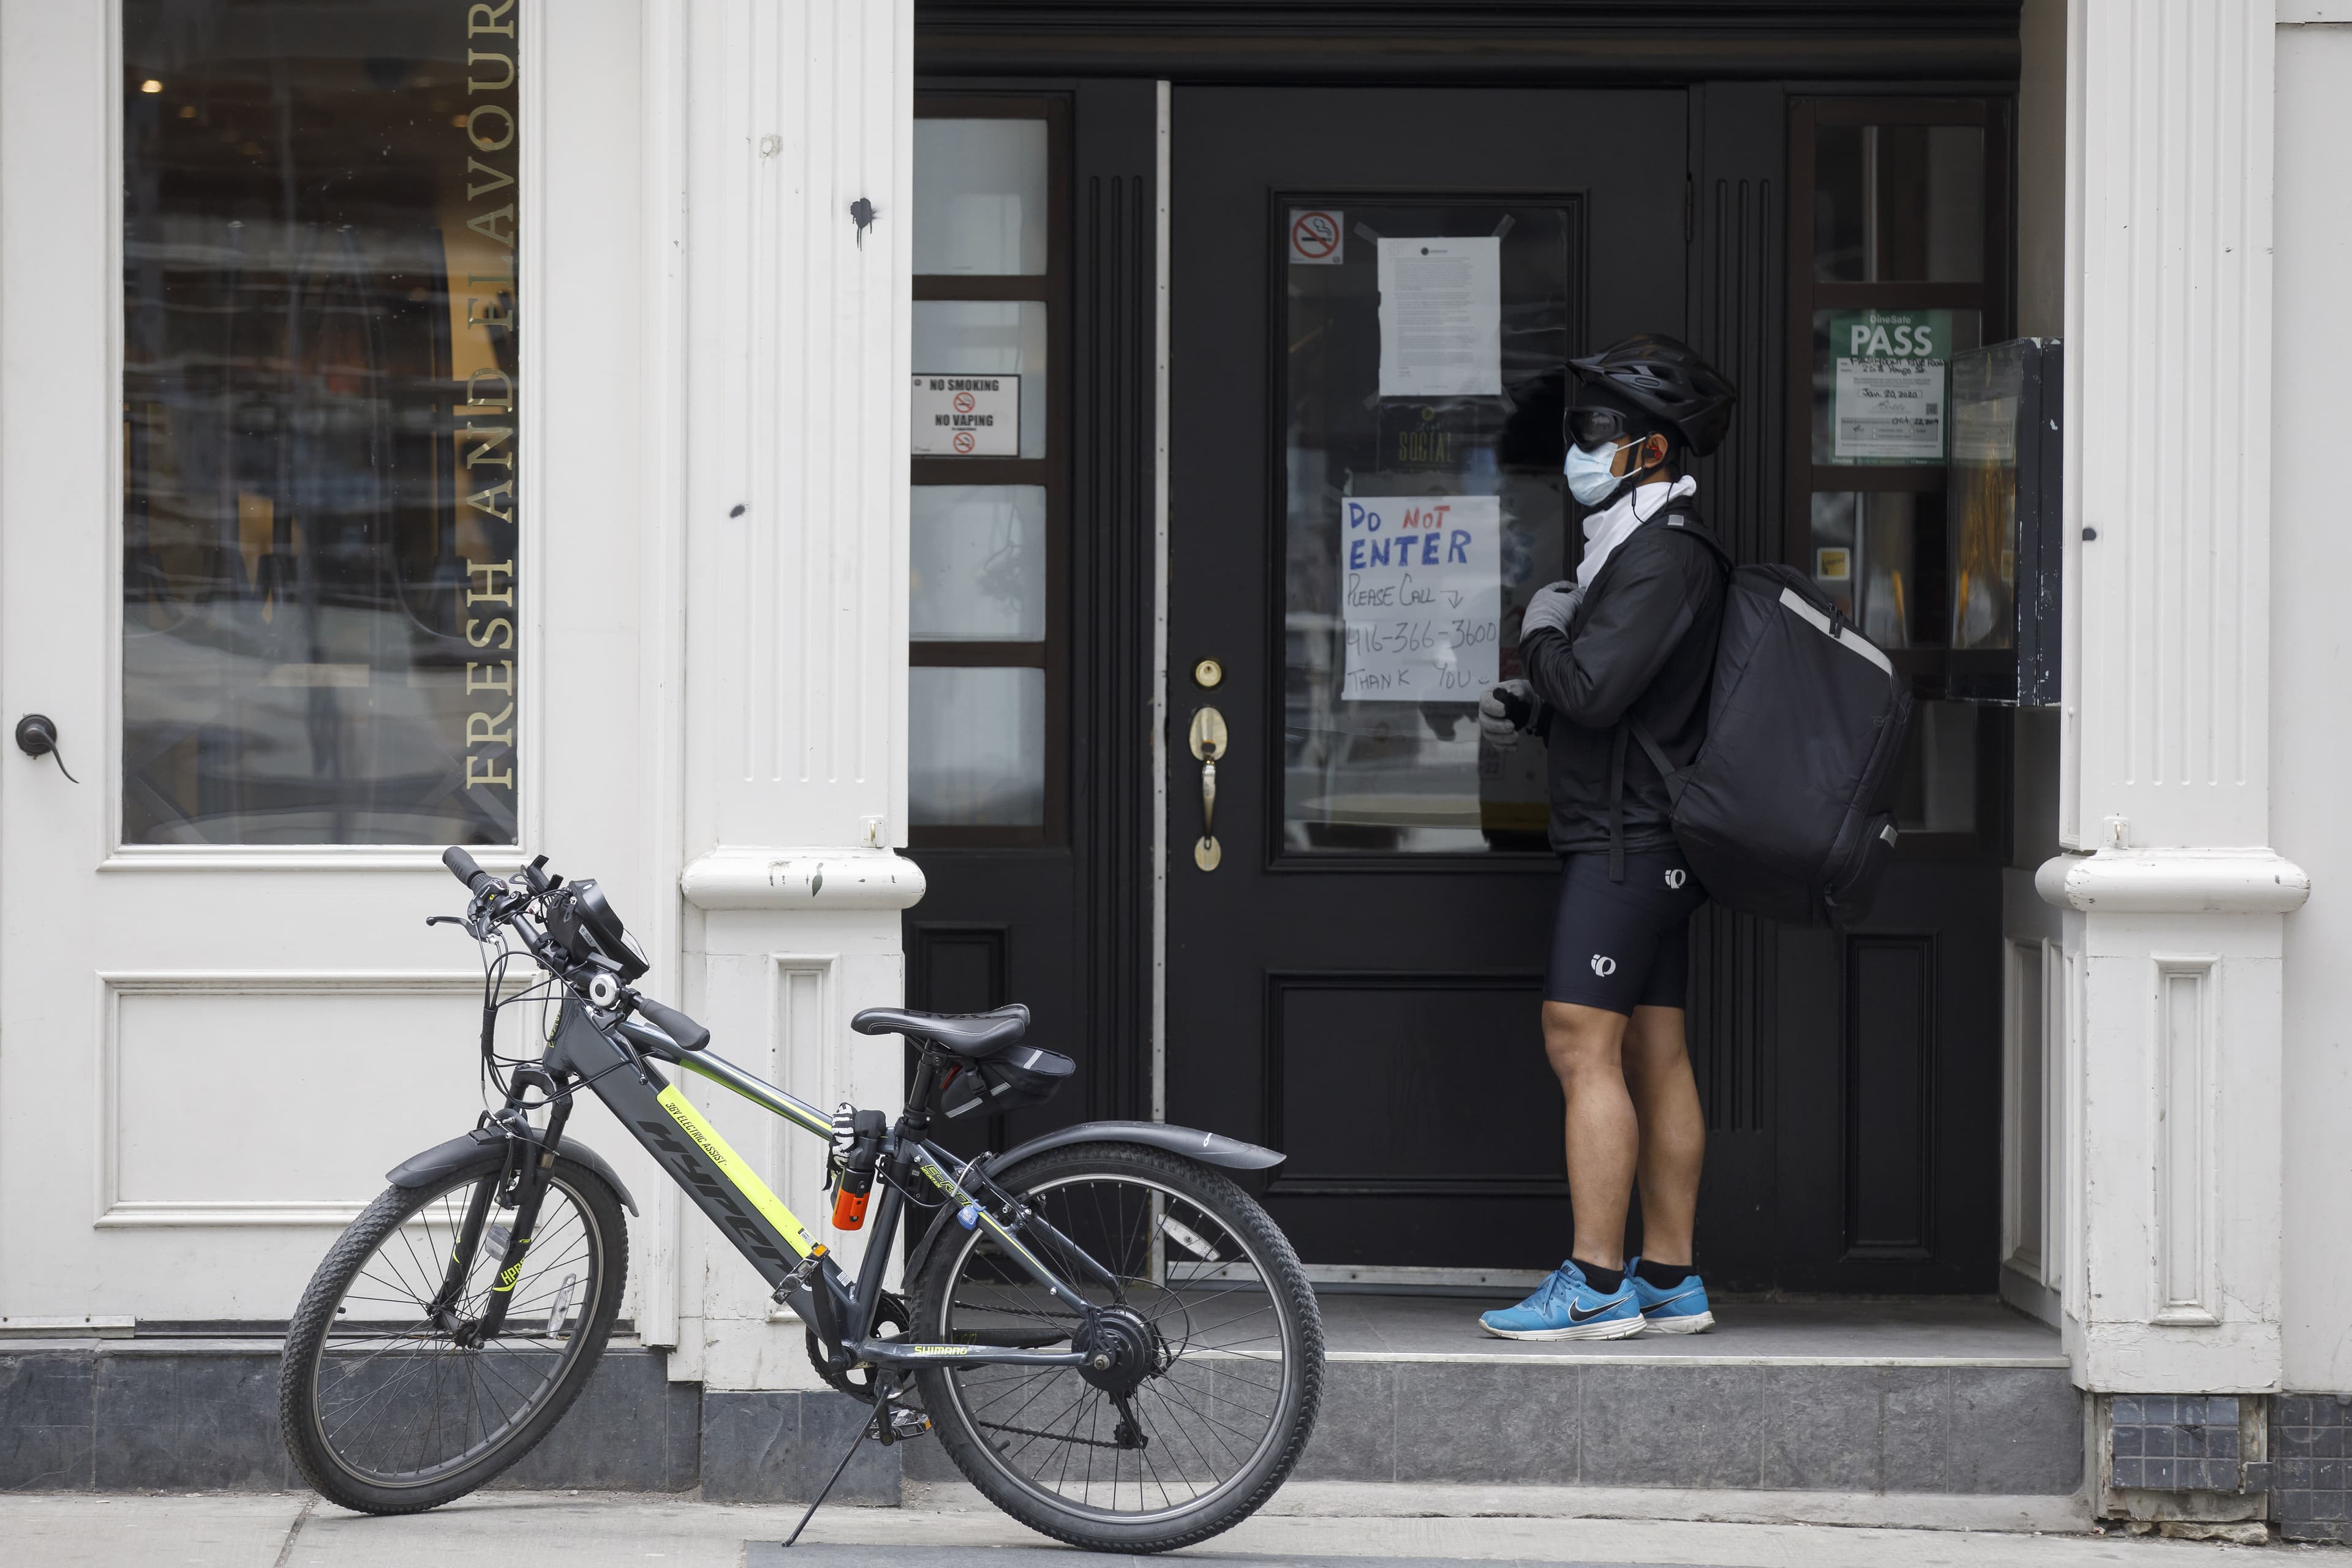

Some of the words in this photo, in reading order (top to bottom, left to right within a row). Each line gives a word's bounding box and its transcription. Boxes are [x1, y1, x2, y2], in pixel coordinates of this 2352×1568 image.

[466, 0, 515, 330] FLAVOUR
[1850, 325, 1932, 356] PASS
[930, 379, 944, 391] NO
[948, 379, 999, 391] SMOKING
[935, 415, 949, 426] NO
[953, 415, 993, 426] VAPING
[466, 368, 513, 523] AND
[1399, 431, 1451, 462] SOCIAL
[1349, 502, 1381, 532] DO
[1402, 505, 1450, 529] NOT
[1349, 529, 1472, 570] ENTER
[1348, 573, 1395, 607] PLEASE
[1400, 573, 1436, 606] CALL
[1347, 619, 1497, 656] 416-366-3600
[466, 559, 513, 790] FRESH
[1433, 662, 1471, 689] YOU
[665, 1102, 682, 1115] 36V
[677, 1115, 707, 1143] ELECTRIC
[702, 1144, 728, 1164] ASSIST
[920, 1167, 942, 1189] MOUNTAIN
[914, 1346, 968, 1355] SHIMANO
